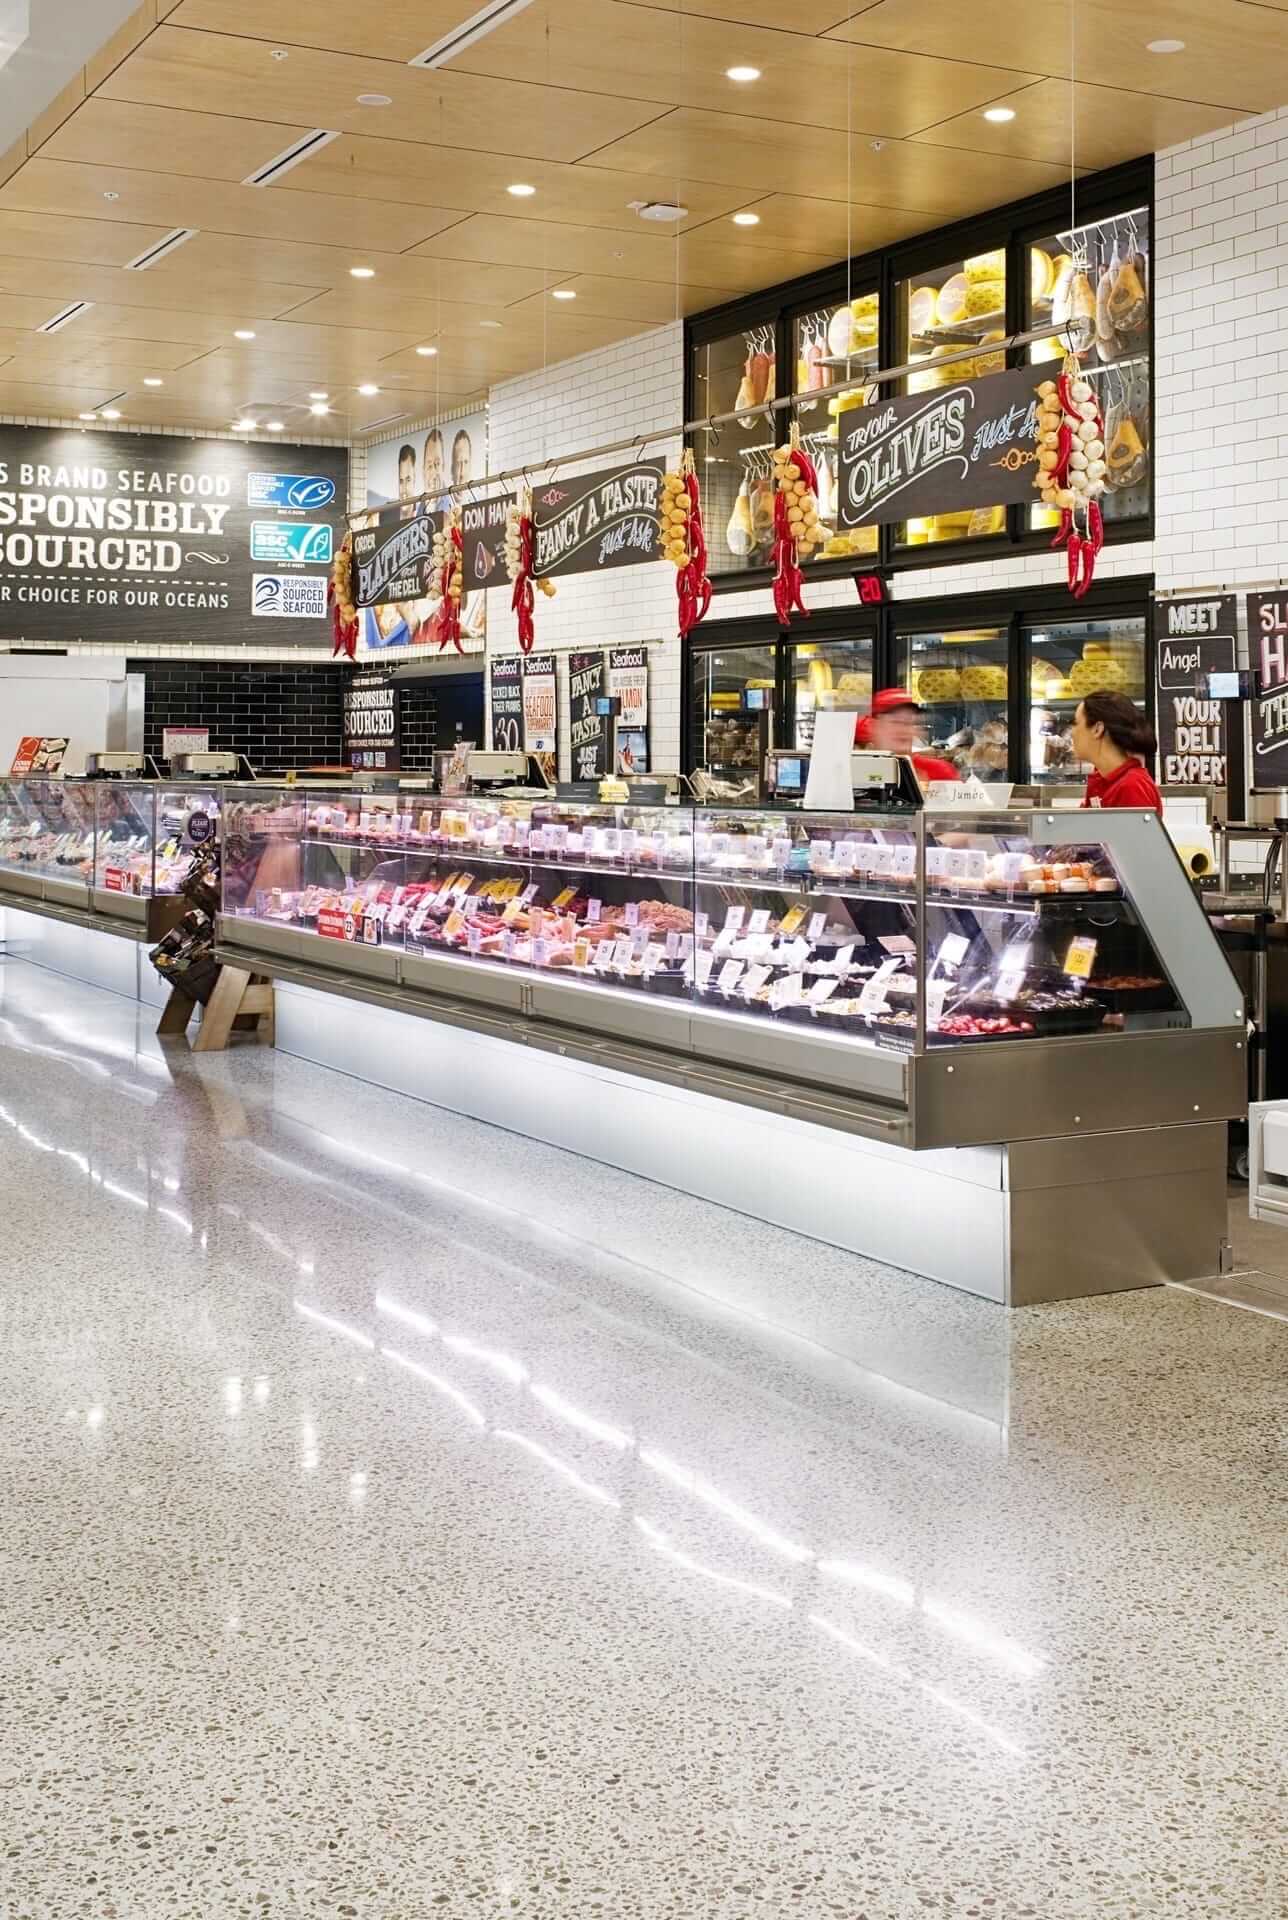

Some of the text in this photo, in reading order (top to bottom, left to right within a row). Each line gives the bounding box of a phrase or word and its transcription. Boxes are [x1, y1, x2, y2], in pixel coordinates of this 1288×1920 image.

[848, 398, 965, 507] OLIVES
[20, 464, 107, 490] BRAND
[118, 470, 231, 496] SEAFOOD
[536, 503, 585, 567] FANCY
[584, 496, 600, 534] A
[601, 475, 658, 520] TASTE
[0, 533, 182, 572] OURCED
[358, 518, 429, 602] PLATTERS
[283, 577, 324, 588] RESPONSIBLY
[283, 588, 324, 600] SOURCED
[387, 581, 402, 600] THE
[18, 587, 80, 603] CHOICE
[87, 589, 119, 605] FOR
[125, 591, 159, 606] OUR
[165, 592, 229, 608] OCEANS
[283, 601, 324, 613] SEAFOOD
[1168, 601, 1222, 634] MEET
[1258, 602, 1288, 632] SL
[492, 660, 517, 676] Seafood
[526, 657, 553, 673] Seafood
[612, 650, 643, 667] Seafood
[1162, 645, 1201, 674] Angel
[1260, 634, 1288, 689] H
[571, 665, 601, 700] FANCY
[344, 689, 394, 709] RESPONSIBLY
[582, 695, 592, 718] A
[1173, 695, 1222, 726] YOUR
[344, 710, 395, 736] SOURCED
[572, 716, 601, 744] TASTE
[1176, 726, 1220, 755] DELI
[577, 745, 598, 764] JUST
[580, 763, 598, 780] ASK
